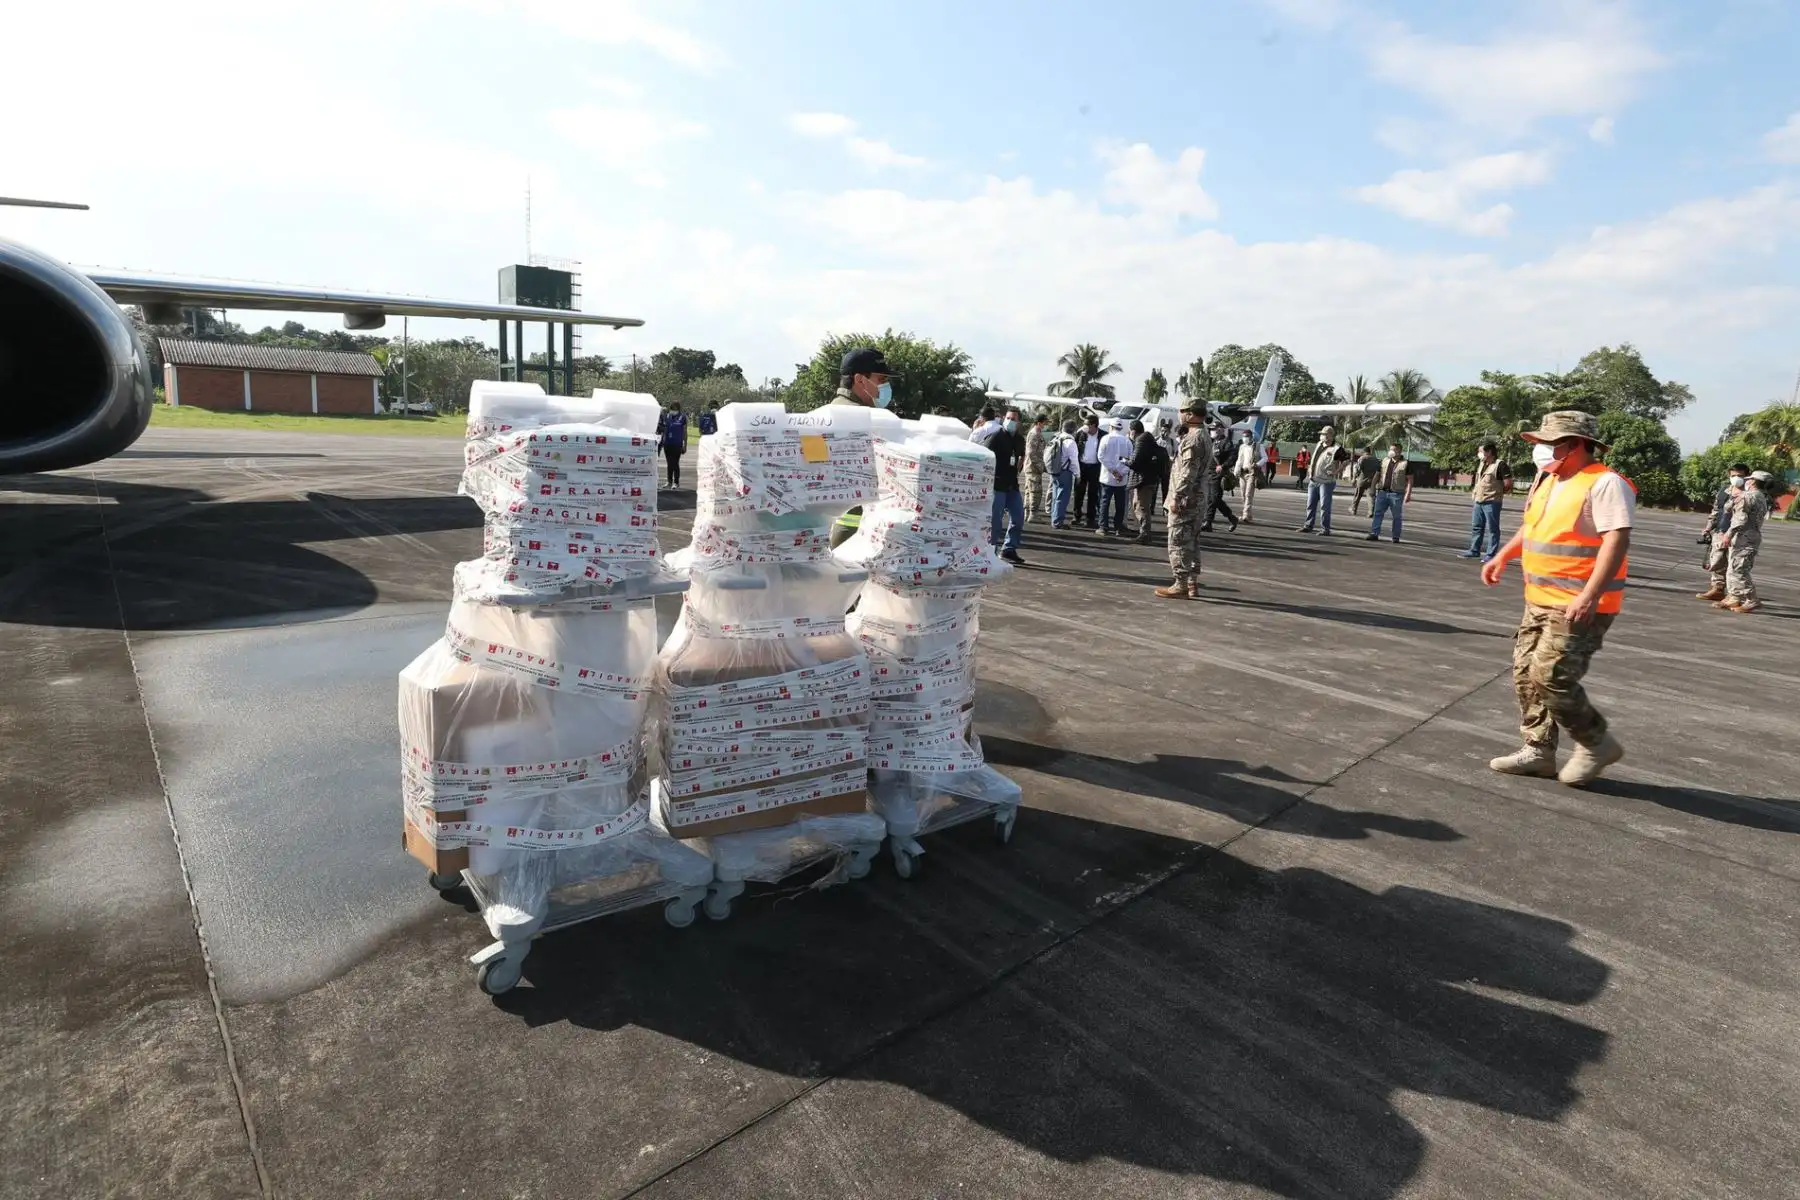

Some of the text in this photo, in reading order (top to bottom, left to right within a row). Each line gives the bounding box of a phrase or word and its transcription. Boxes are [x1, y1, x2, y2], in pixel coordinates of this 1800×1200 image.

[530, 434, 592, 443] RAGIL
[588, 455, 646, 464] FRAGIL
[555, 485, 629, 496] FRAGIL
[816, 493, 856, 501] FRAGIL
[518, 505, 593, 520] FRAGIL
[511, 557, 544, 568] GIL
[499, 647, 556, 668] FRAGIL
[807, 673, 852, 689] FRAGIL
[728, 690, 778, 703] FRAGIL
[673, 703, 697, 712] GIL
[839, 703, 868, 713] FRAG
[763, 713, 812, 726] FRAGIL
[682, 724, 734, 736] FRAGIL
[911, 736, 950, 747] FRAGIL
[677, 744, 729, 753] FRAGIL
[799, 757, 844, 770] FRAGIL
[438, 767, 480, 775] FRAG
[722, 772, 771, 787] FRAGIL
[838, 783, 867, 793] FRAG
[765, 793, 811, 808] FRAGIL
[685, 809, 736, 823] FRAGIL
[441, 823, 482, 832] FRAG
[520, 829, 574, 840] FRAGIL
